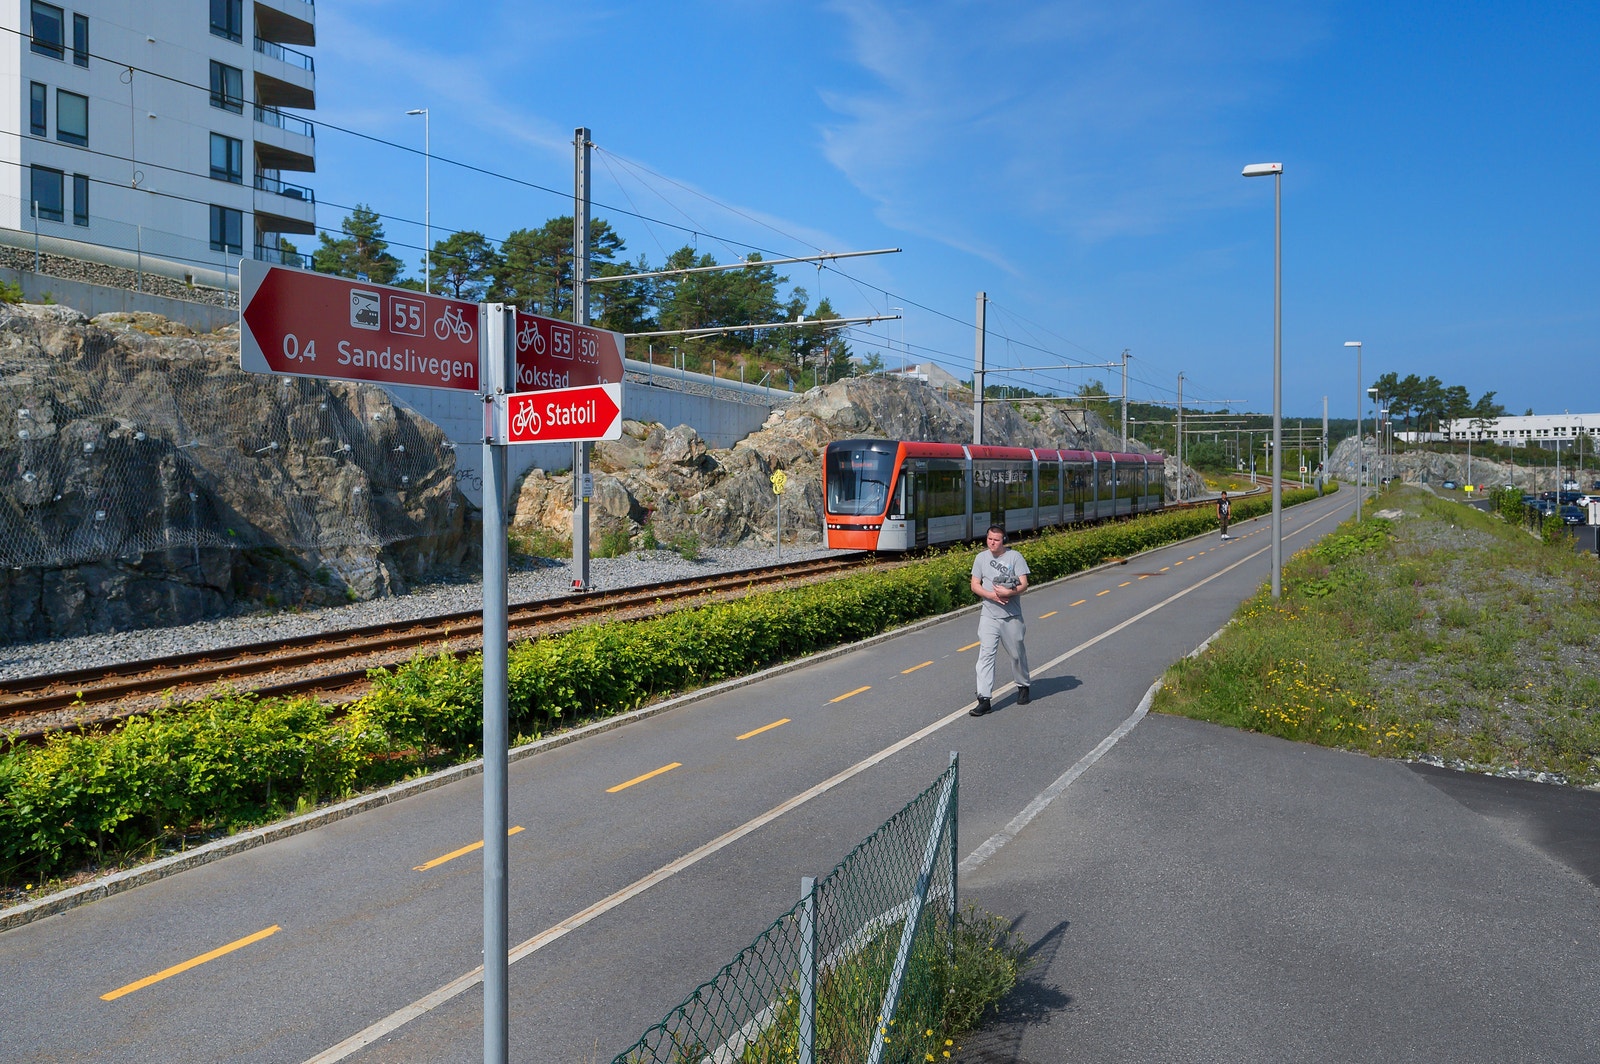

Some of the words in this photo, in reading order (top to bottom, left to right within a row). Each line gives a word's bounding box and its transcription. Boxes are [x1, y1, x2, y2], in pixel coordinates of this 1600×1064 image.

[395, 303, 420, 330] 55
[283, 333, 317, 363] 0,4
[337, 340, 474, 382] Sandslivegen
[554, 331, 571, 354] 55
[581, 338, 596, 357] 50
[516, 363, 569, 388] Kokstad
[546, 399, 596, 426] Statoil
